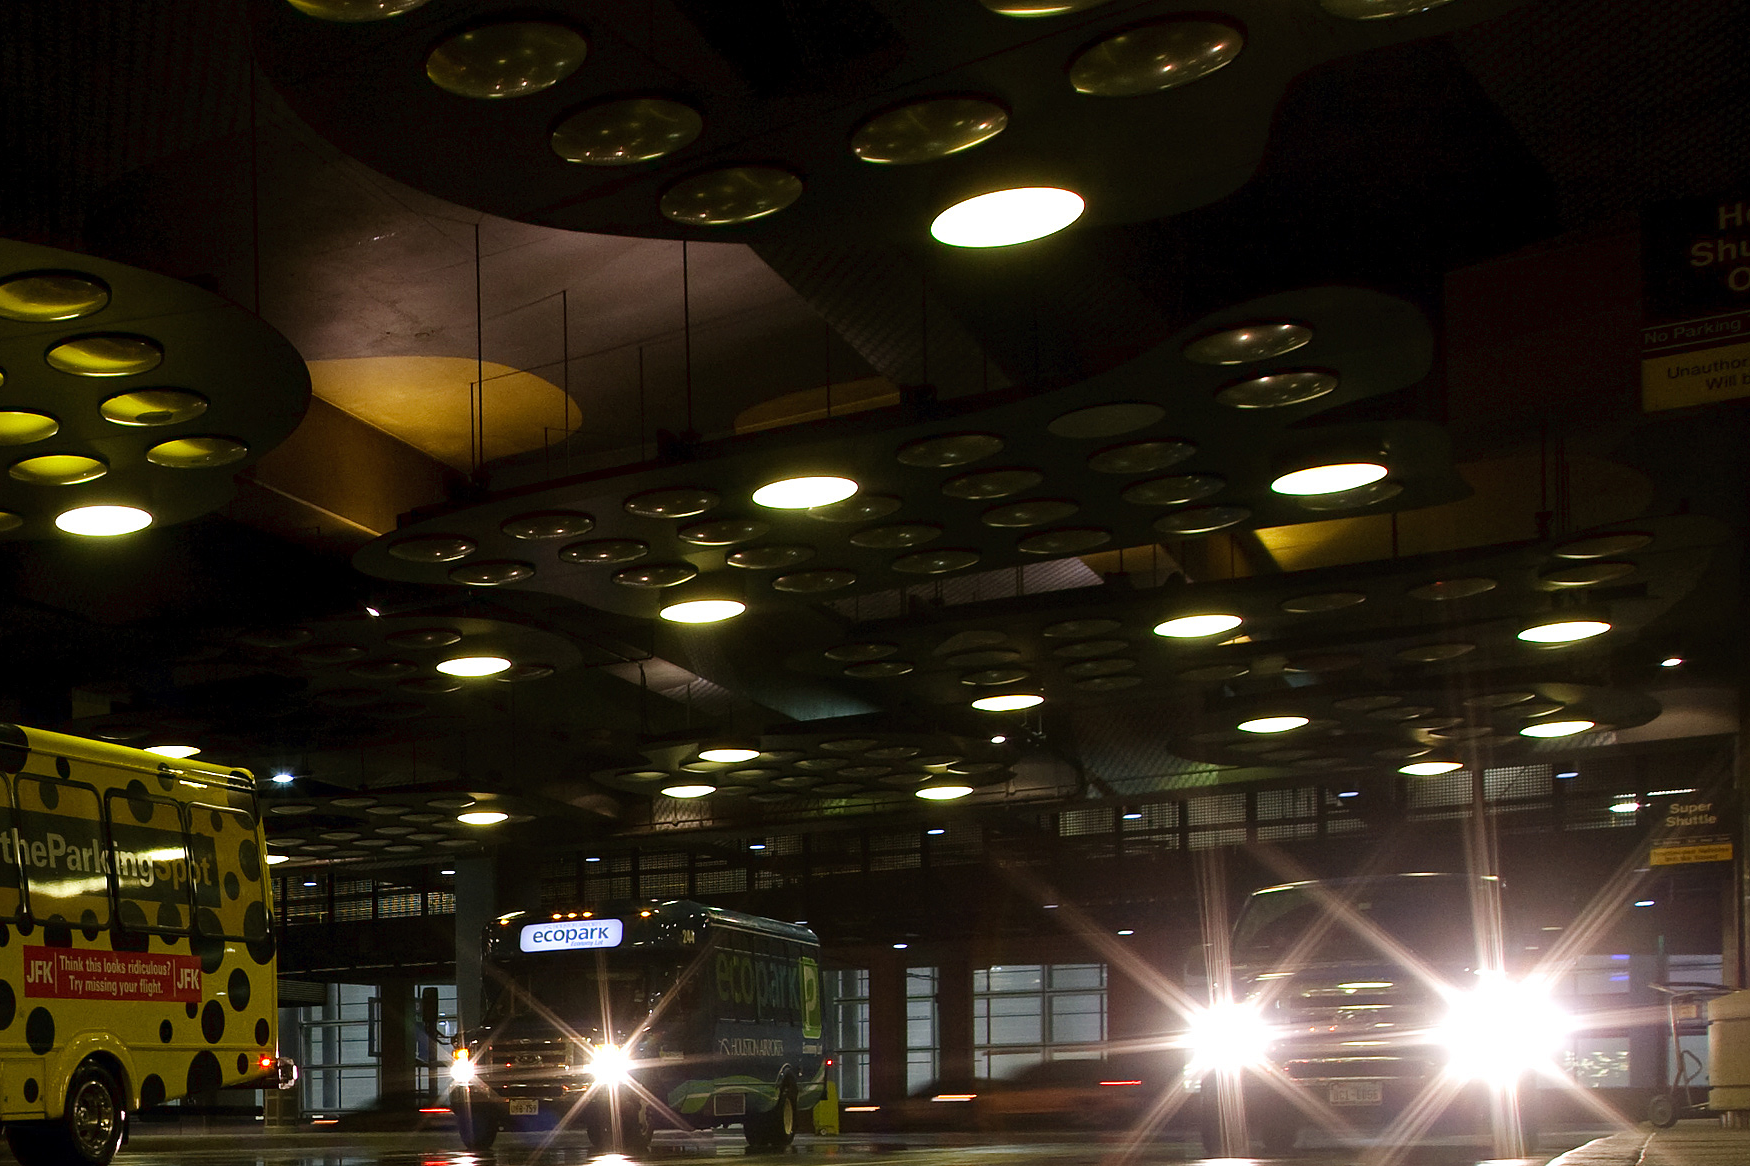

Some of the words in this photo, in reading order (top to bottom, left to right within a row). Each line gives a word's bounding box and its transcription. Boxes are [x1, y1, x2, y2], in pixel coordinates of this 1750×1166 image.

[1718, 201, 1750, 231] H
[1644, 330, 1668, 345] No
[1673, 319, 1742, 340] Parking
[1706, 374, 1737, 390] Will
[1670, 803, 1713, 815] Super
[1666, 814, 1717, 827] Shuttle
[532, 927, 609, 943] ecopark
[26, 960, 53, 984] JFK
[59, 955, 83, 971] Think
[86, 957, 102, 972] this
[104, 958, 126, 974] looks
[128, 959, 171, 976] ridiculous?
[69, 975, 83, 995] Try
[85, 977, 118, 996] missing
[119, 981, 138, 996] your
[139, 978, 164, 997] flight.
[177, 968, 200, 990] JFK
